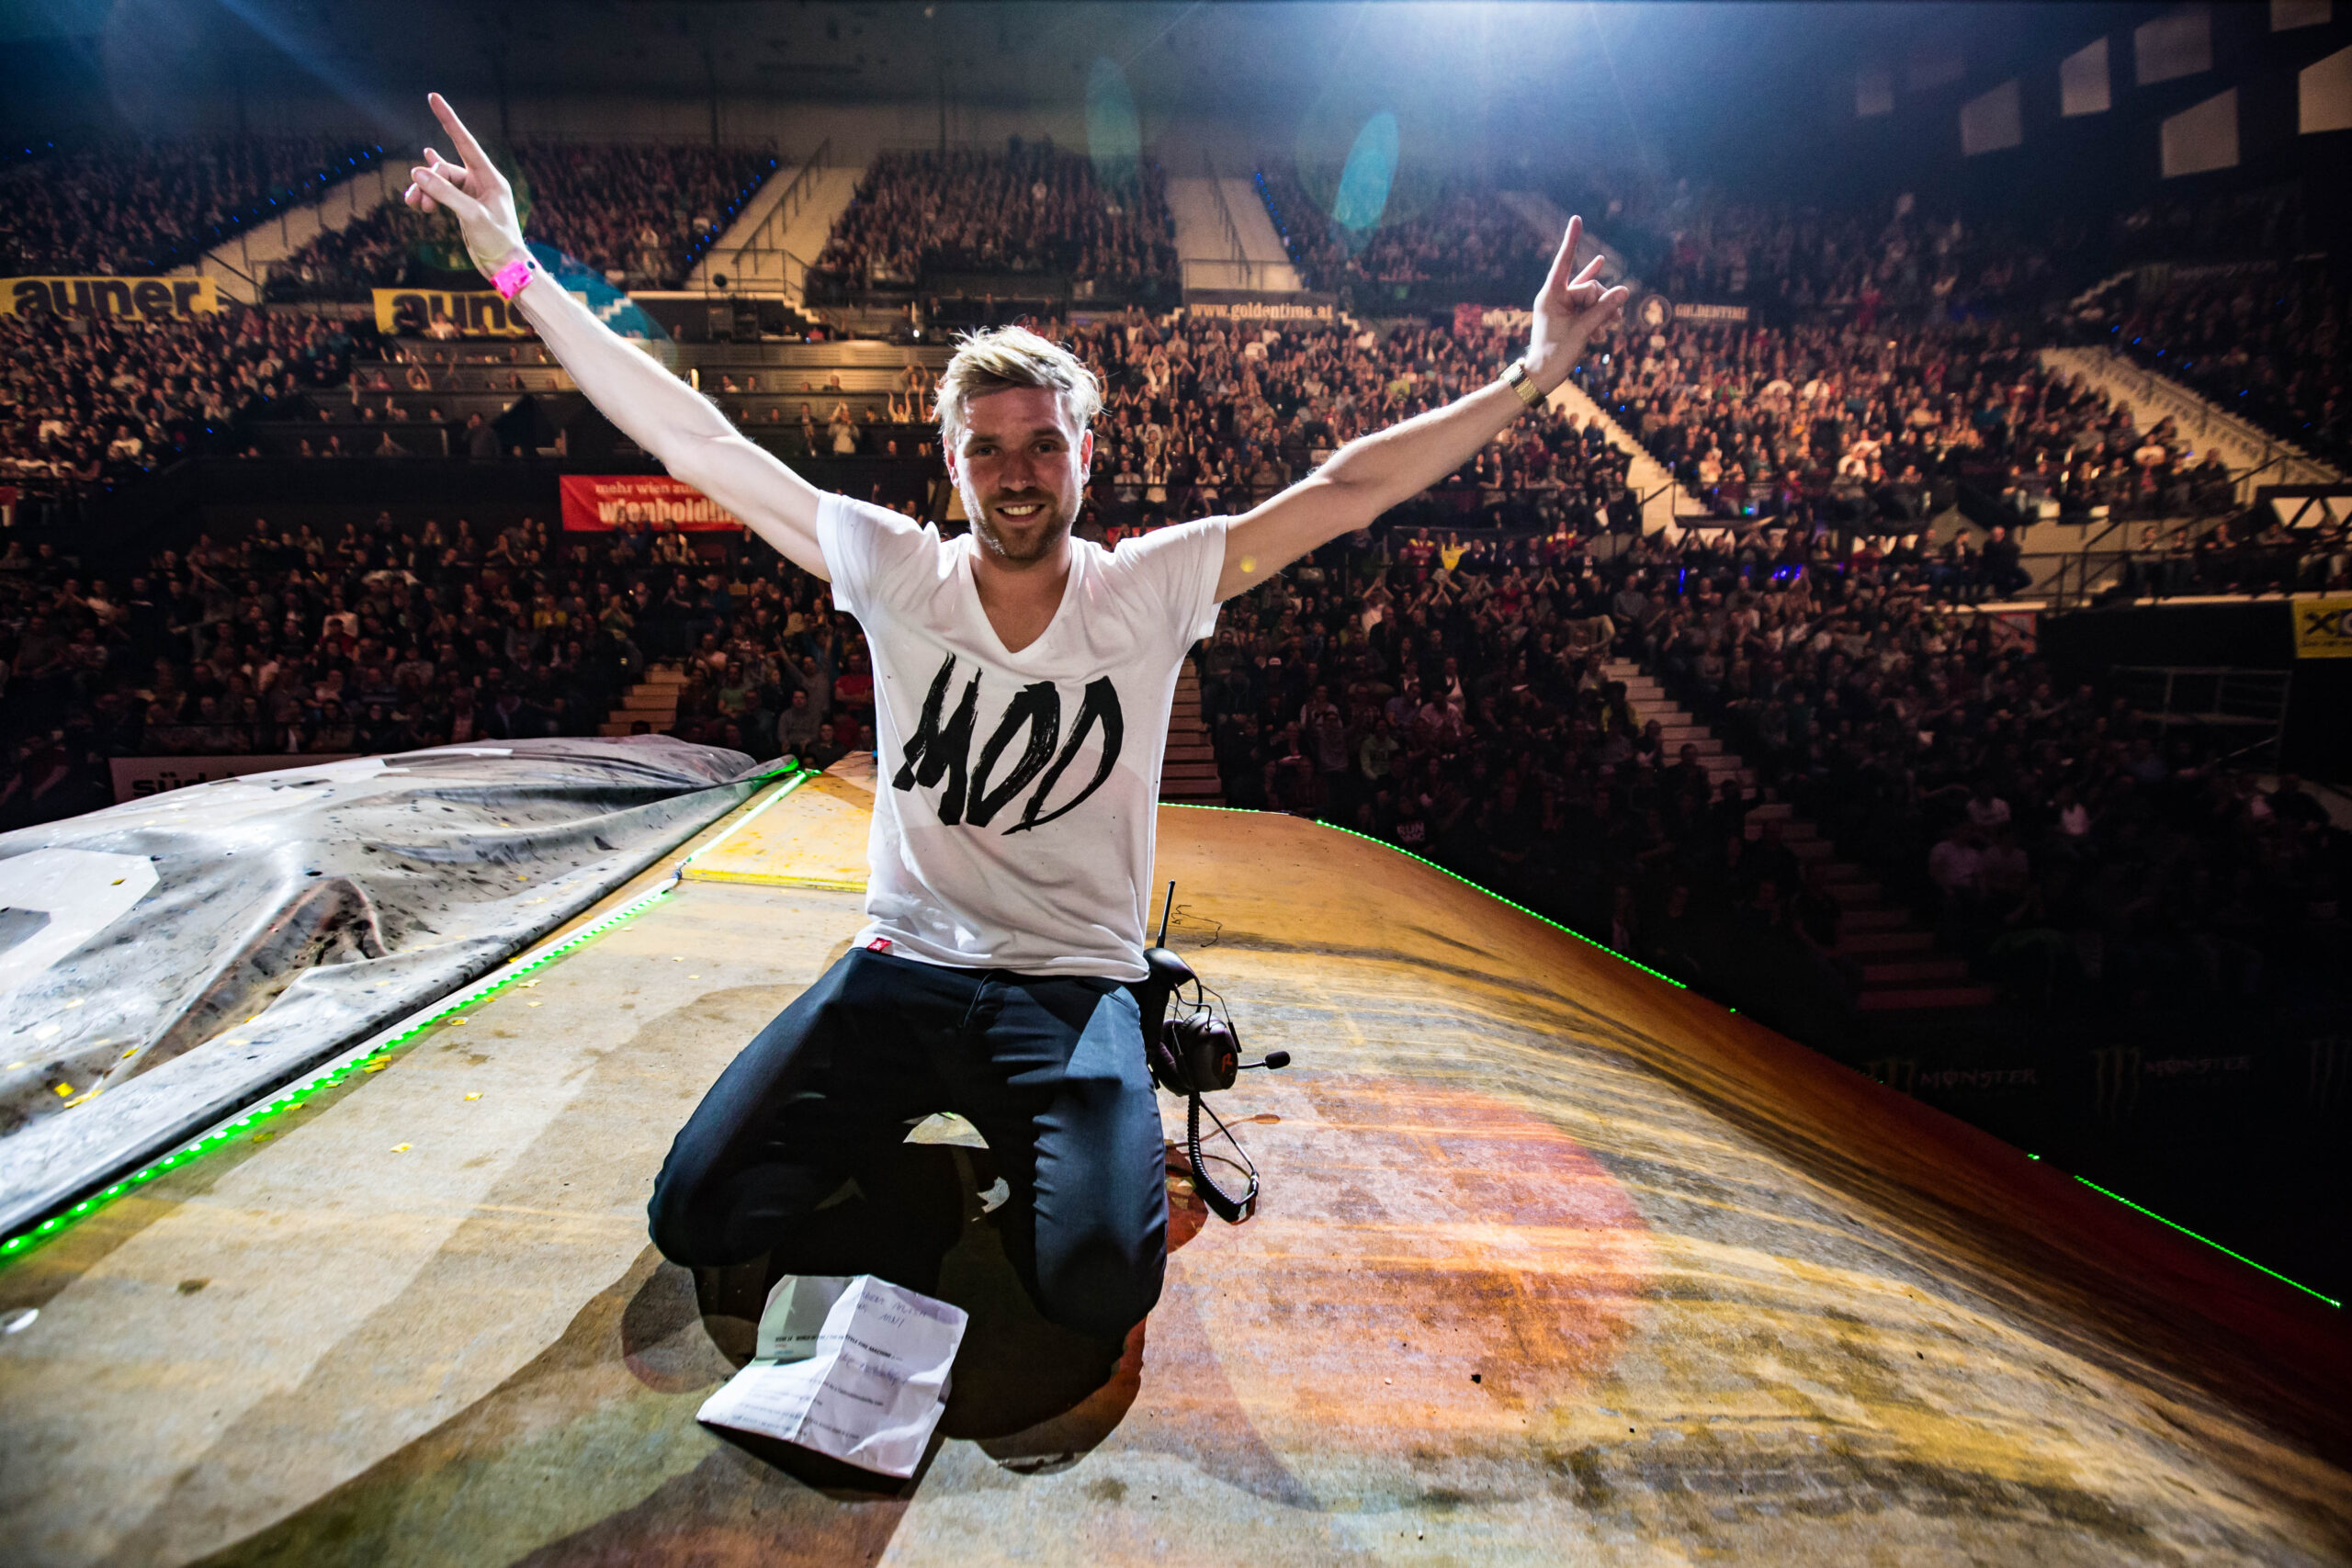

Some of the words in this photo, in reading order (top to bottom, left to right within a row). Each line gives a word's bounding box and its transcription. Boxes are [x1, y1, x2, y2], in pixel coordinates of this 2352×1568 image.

[13, 279, 200, 319] auner
[1190, 301, 1333, 321] www.goldentime.at
[595, 481, 632, 494] mehr
[636, 481, 671, 494] wien
[891, 651, 1125, 836] MOD
[1919, 1067, 2037, 1089] MONSTER
